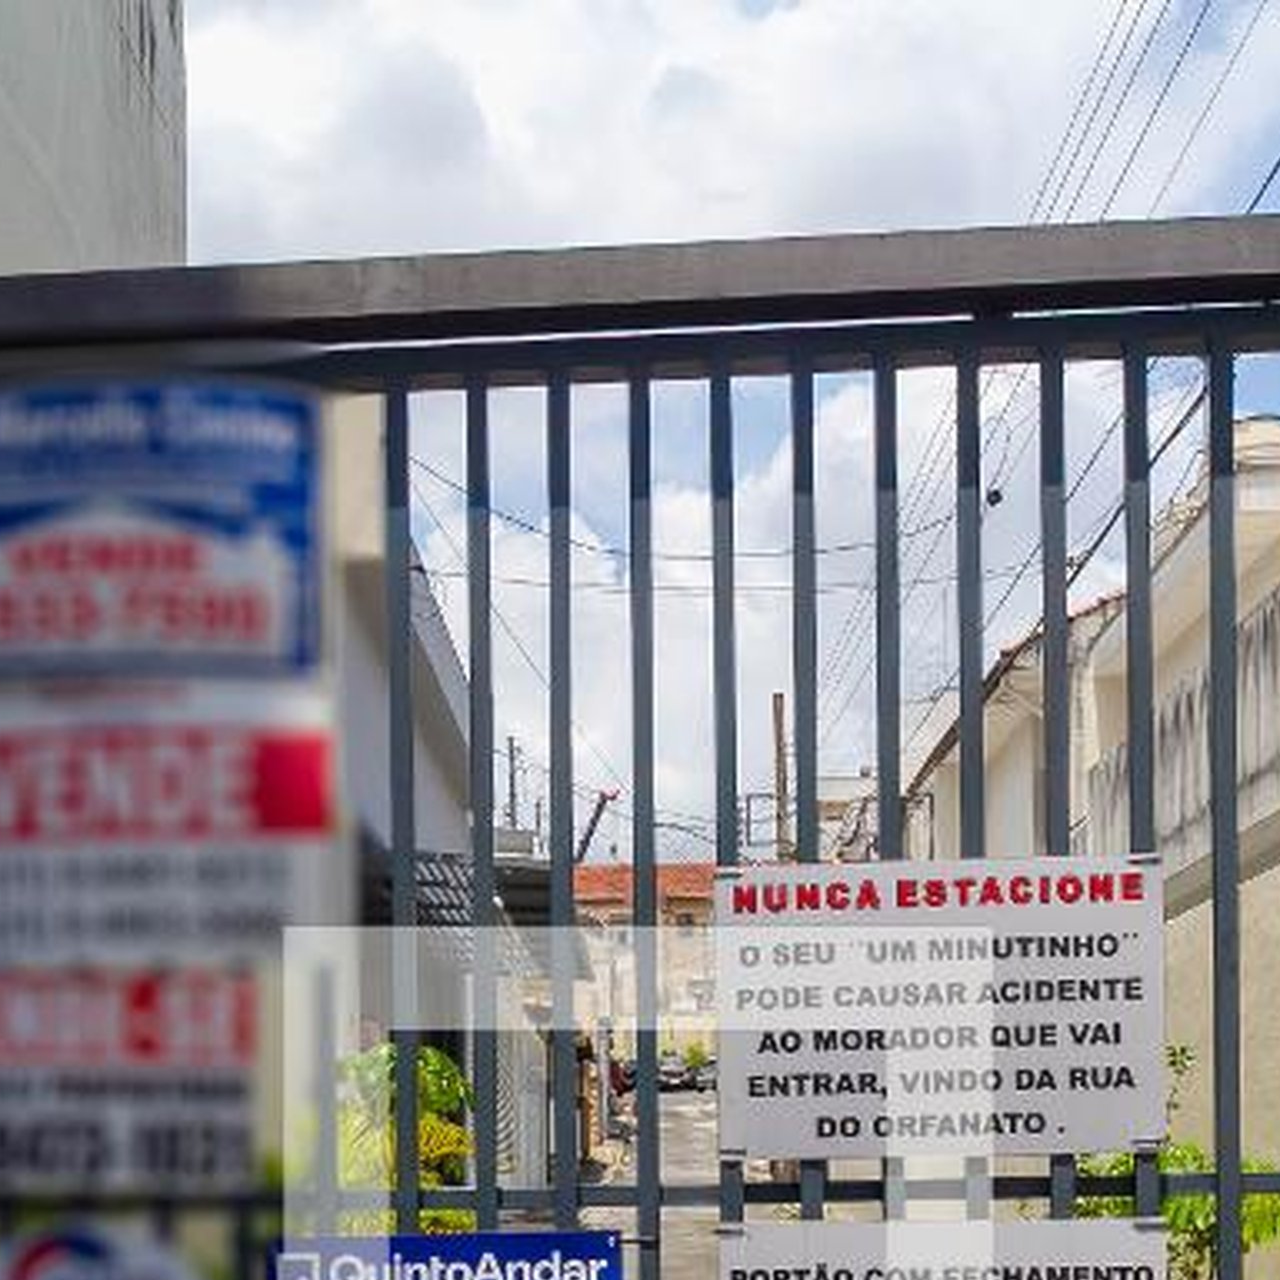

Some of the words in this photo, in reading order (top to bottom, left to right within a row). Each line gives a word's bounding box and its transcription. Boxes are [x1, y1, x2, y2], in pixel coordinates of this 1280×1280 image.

[732, 880, 882, 914] NUNCA
[896, 872, 1146, 909] ESTACIONE
[740, 945, 760, 967] O
[772, 941, 835, 966] SEU
[736, 985, 828, 1010] PODE
[833, 982, 967, 1008] CAUSAR
[979, 976, 1144, 1005] ACIDENTE
[757, 1030, 802, 1054] AO
[813, 1026, 979, 1052] MORADOR
[991, 1023, 1057, 1049] QUE
[1068, 1021, 1123, 1046] VAI
[748, 1072, 888, 1099] ENTRAR,
[899, 1067, 1003, 1094] VINDO
[1015, 1067, 1057, 1091] DA
[1069, 1065, 1136, 1090] RUA
[817, 1115, 860, 1139] DO
[873, 1112, 1045, 1138] ORFANATO
